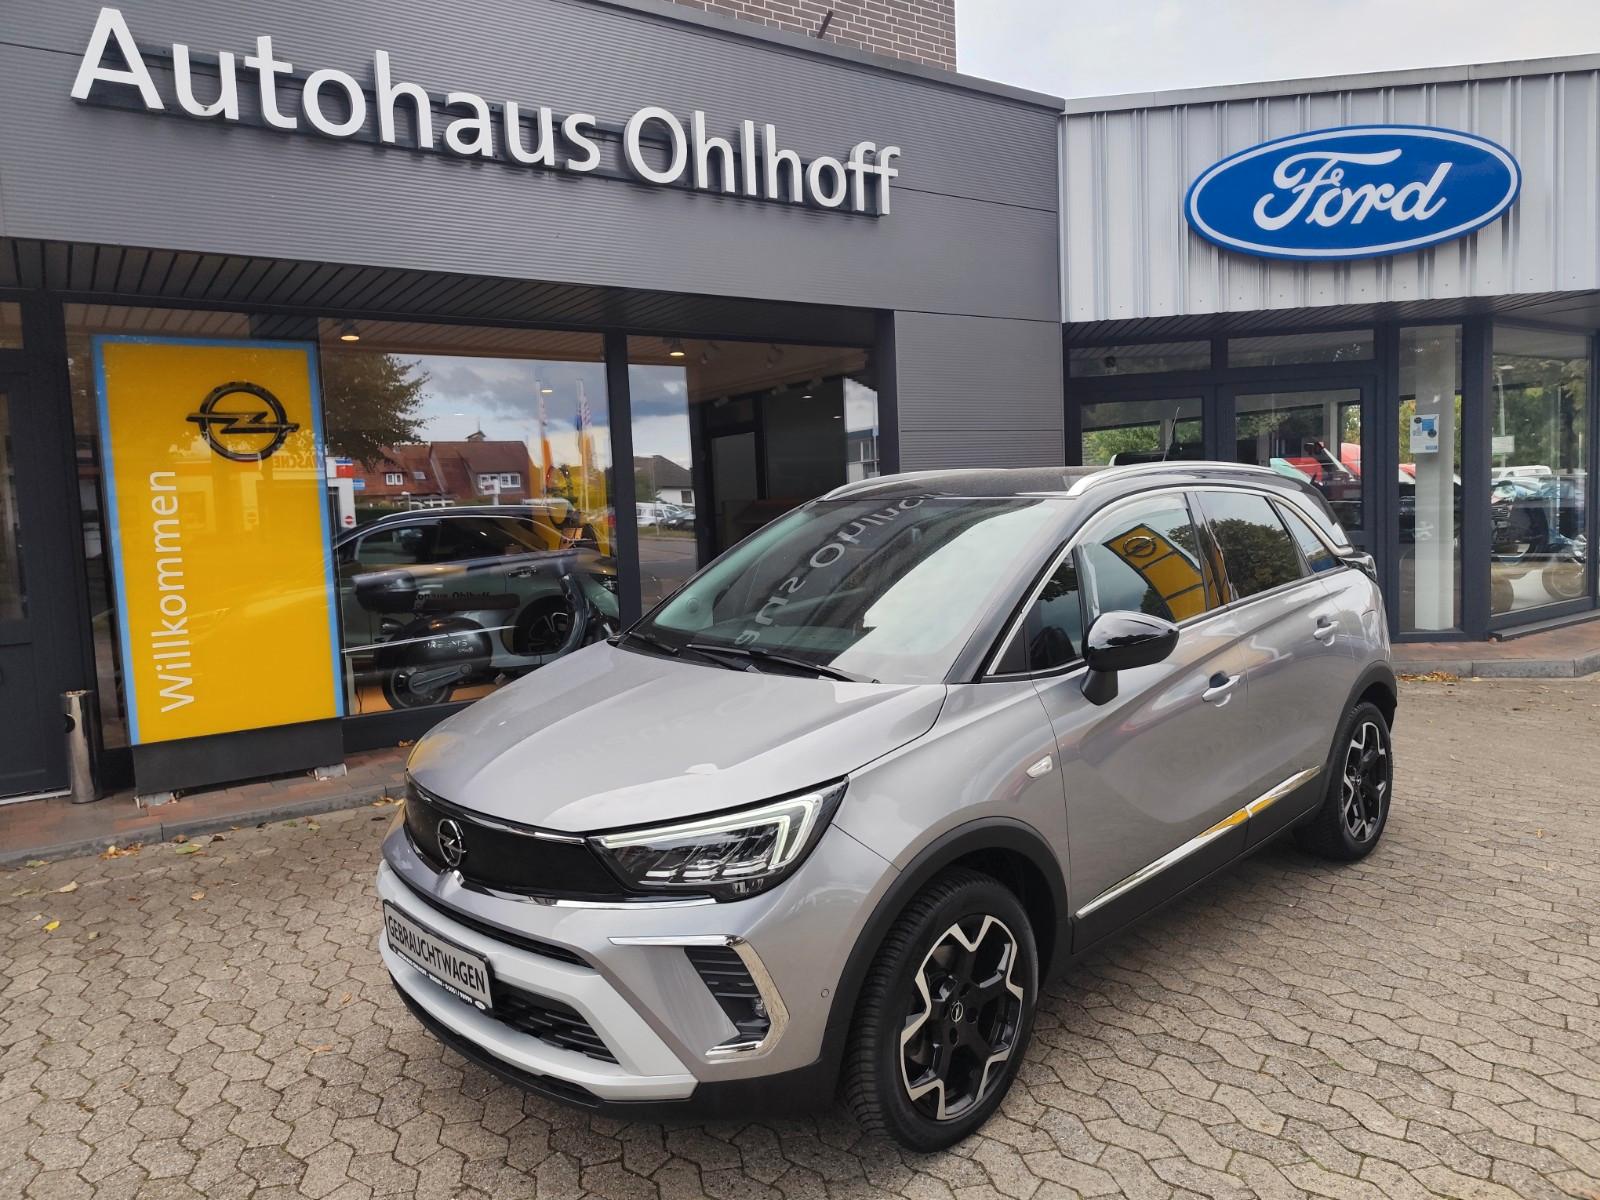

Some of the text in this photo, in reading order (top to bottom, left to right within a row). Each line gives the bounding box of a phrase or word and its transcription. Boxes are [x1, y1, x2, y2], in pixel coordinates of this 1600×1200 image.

[70, 7, 901, 215] Autohaus Ohlhoff
[1253, 148, 1453, 231] Ford
[150, 470, 195, 713] Willkommen
[388, 915, 486, 995] GEBRAUCHTWAGEN
